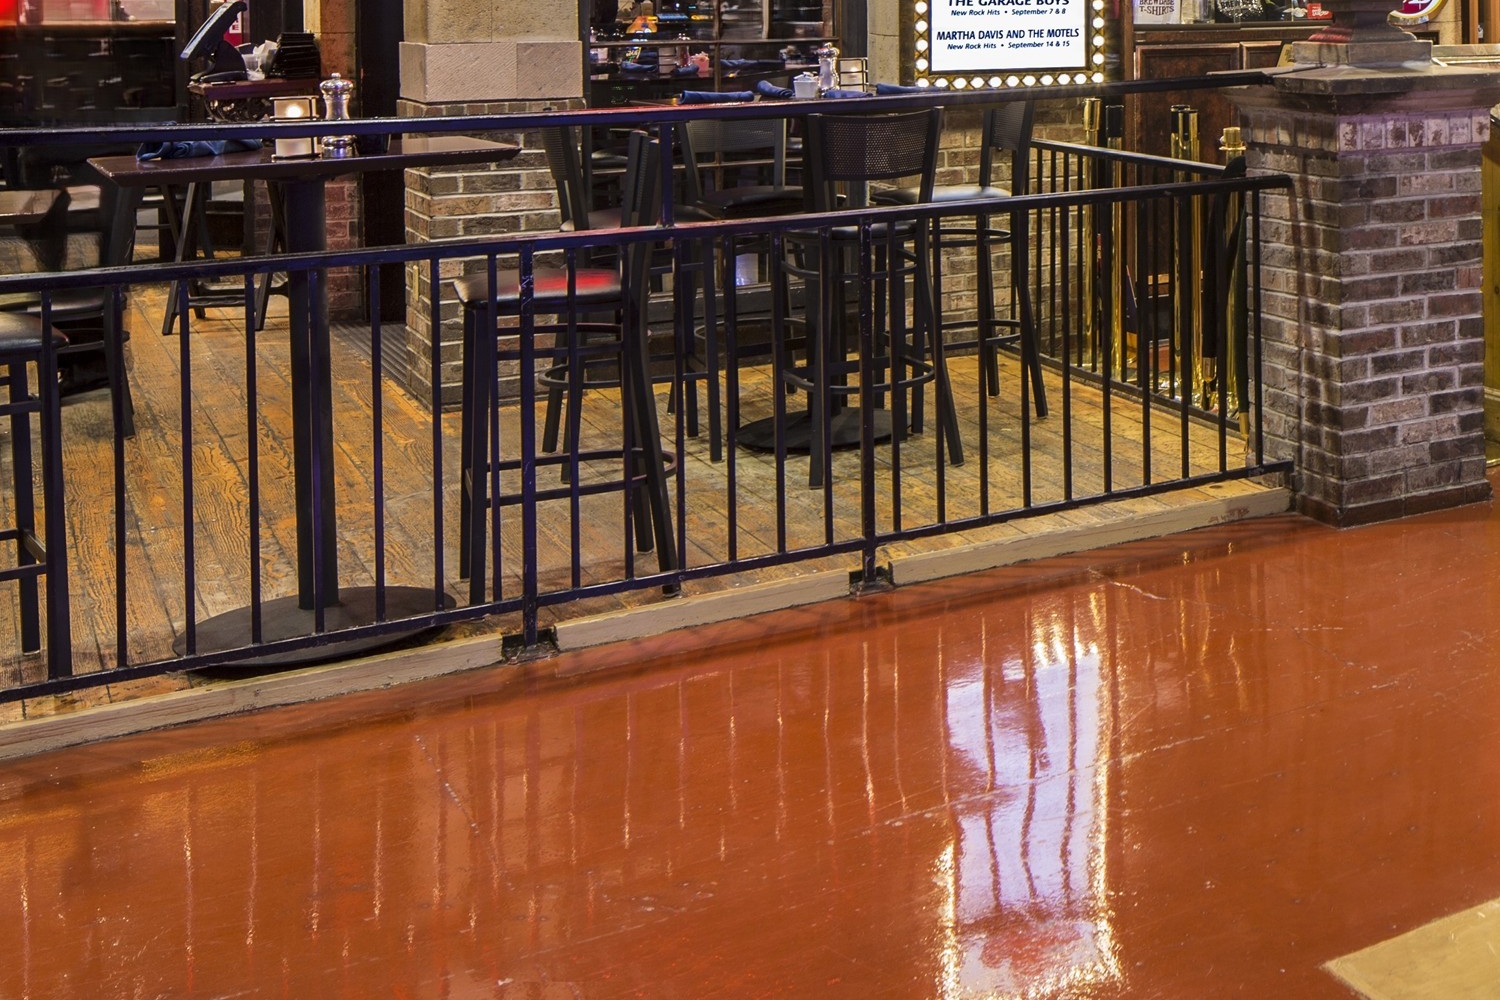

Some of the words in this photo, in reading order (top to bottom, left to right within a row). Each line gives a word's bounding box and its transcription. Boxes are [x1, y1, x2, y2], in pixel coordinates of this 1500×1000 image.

[1012, 8, 1047, 16] September
[1139, 5, 1175, 17] T-SHIRTS
[937, 31, 976, 41] MARTHA
[978, 30, 1004, 40] DAVIS
[1006, 29, 1025, 39] AND
[1028, 29, 1044, 38] THE
[1047, 28, 1079, 38] MOTELS
